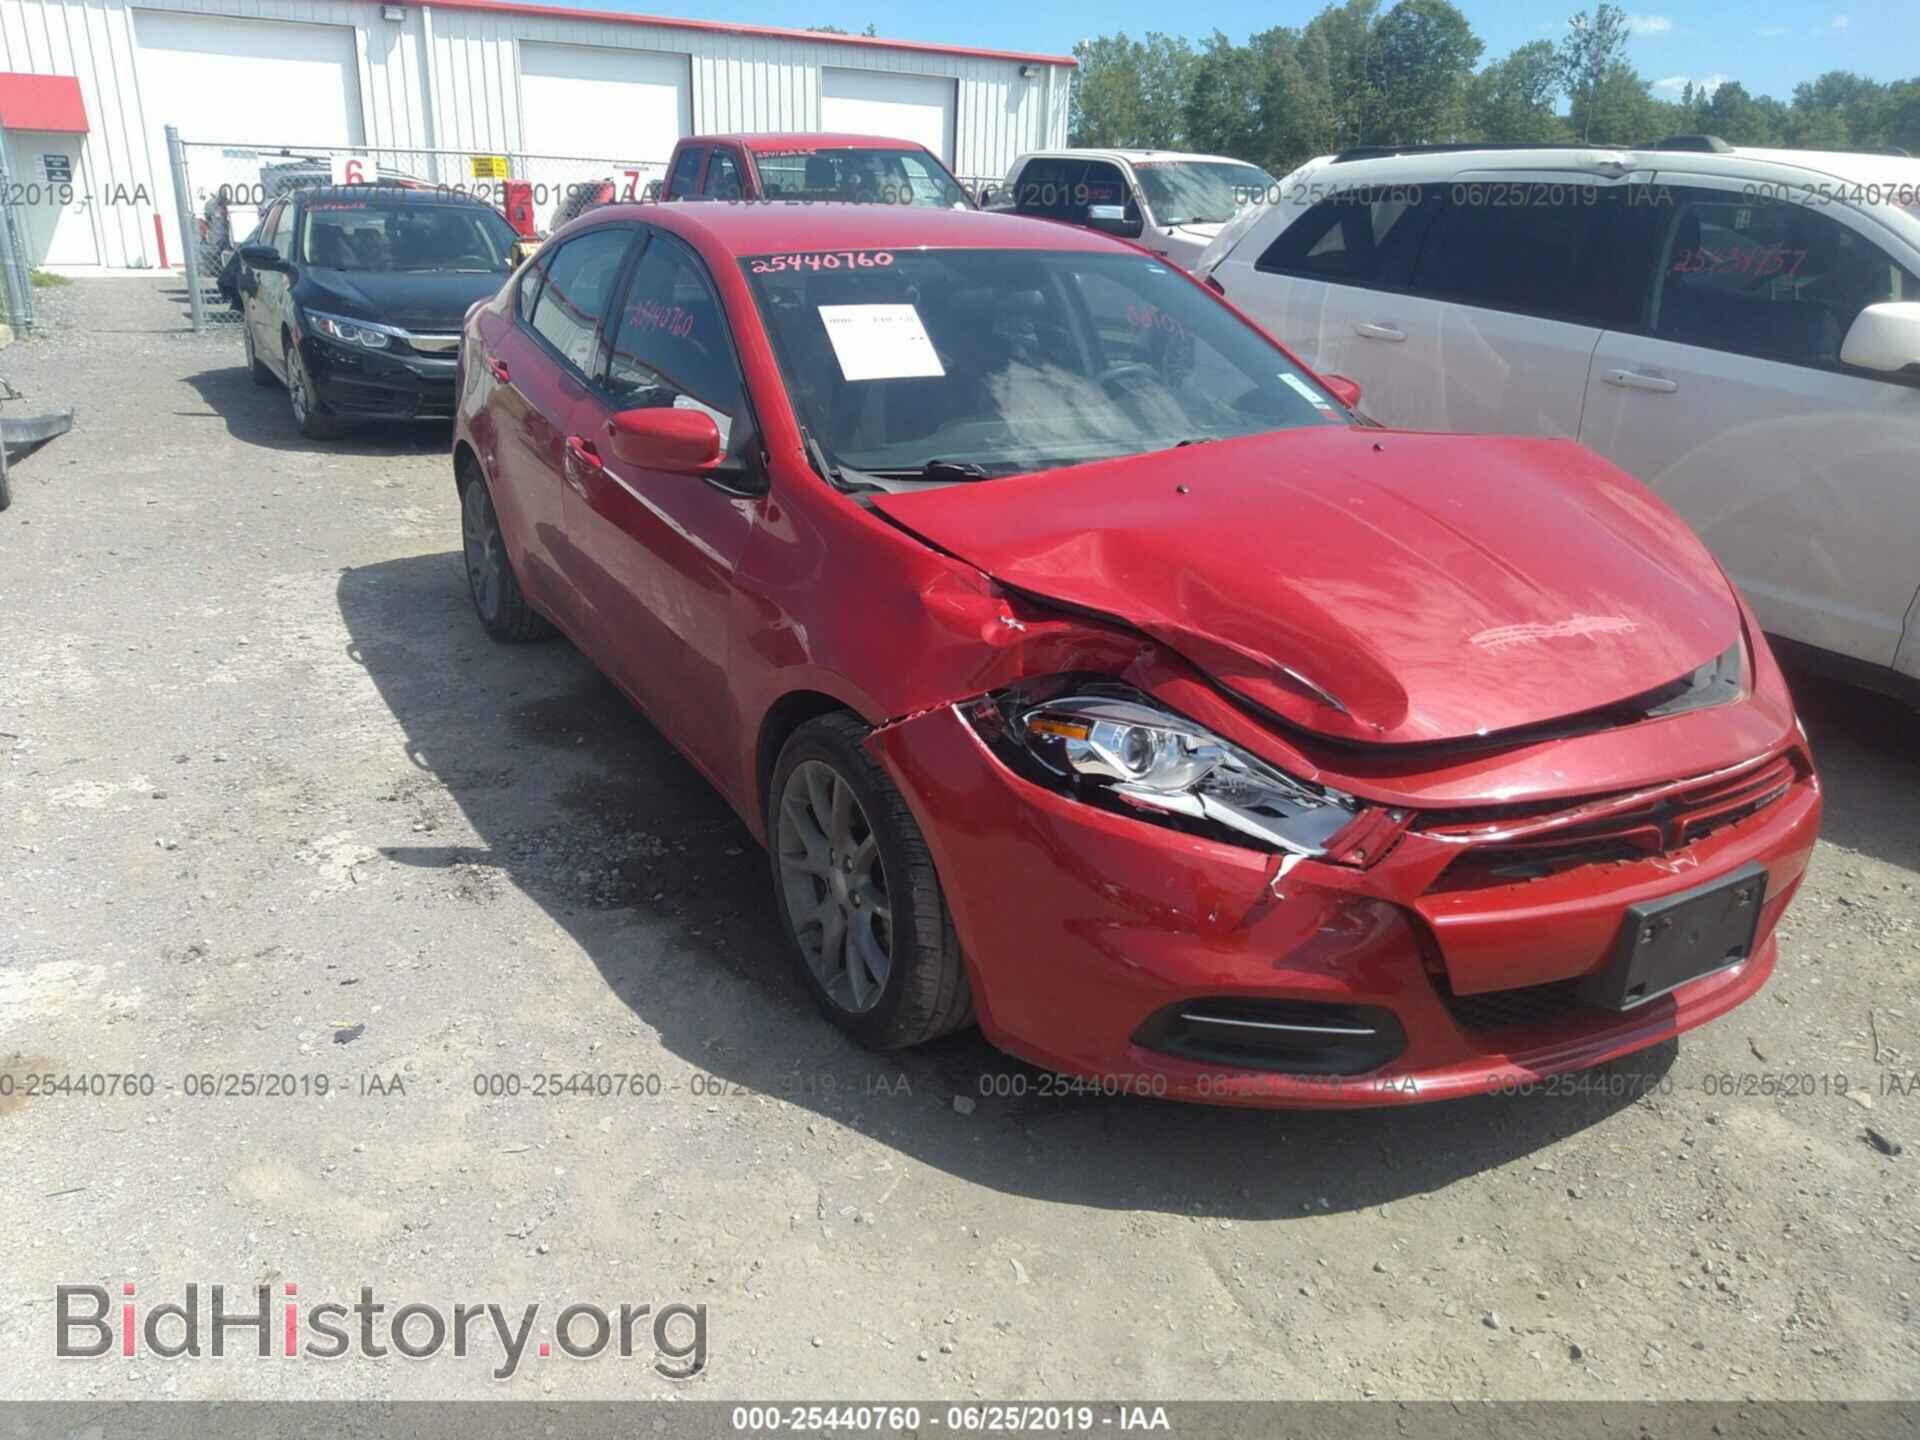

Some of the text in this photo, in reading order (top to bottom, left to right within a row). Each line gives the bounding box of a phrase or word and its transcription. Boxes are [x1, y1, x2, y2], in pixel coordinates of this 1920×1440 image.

[345, 159, 365, 184] 6
[624, 171, 640, 201] 7
[751, 251, 895, 274] 25440760
